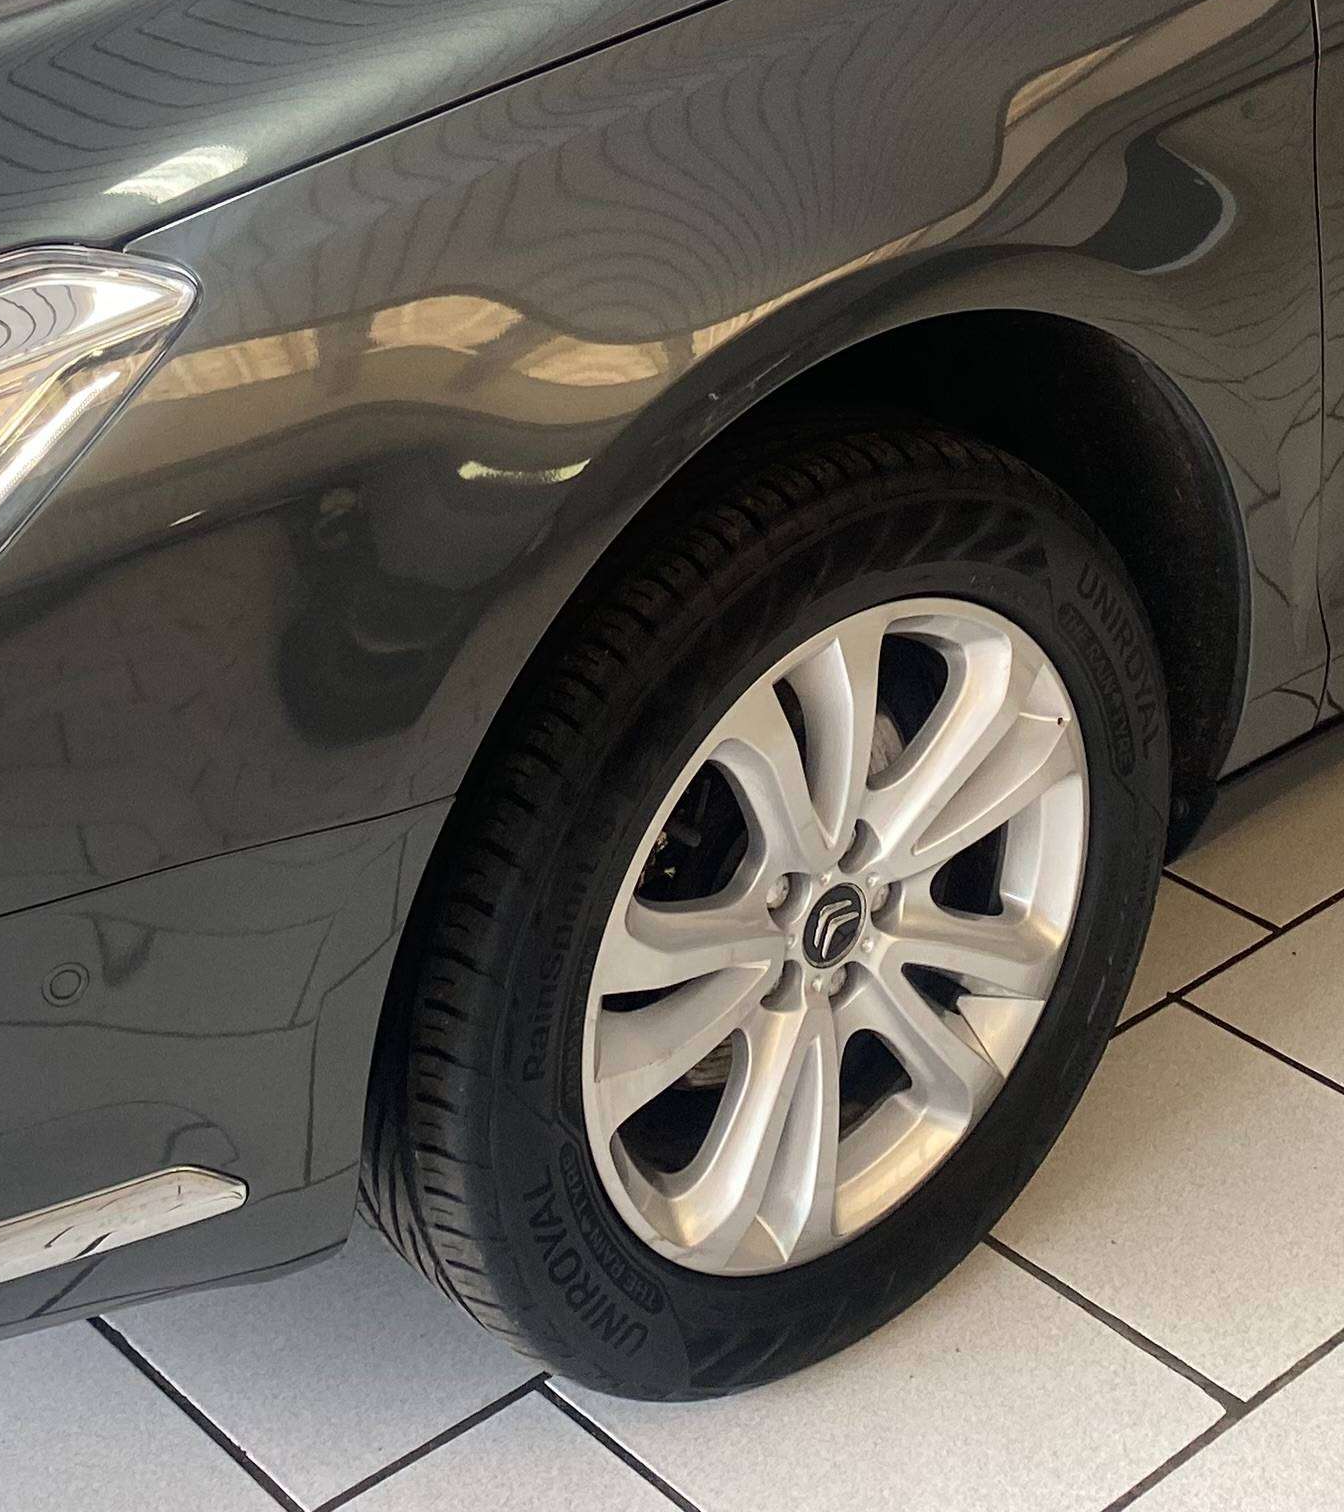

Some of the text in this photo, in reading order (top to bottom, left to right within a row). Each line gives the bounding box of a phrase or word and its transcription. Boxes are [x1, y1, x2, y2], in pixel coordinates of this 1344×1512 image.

[1076, 561, 1159, 760] UNIROYAL
[1083, 638, 1118, 700] RAIN
[523, 1164, 648, 1358] UNIROYAL
[585, 1223, 627, 1282] RAIN
